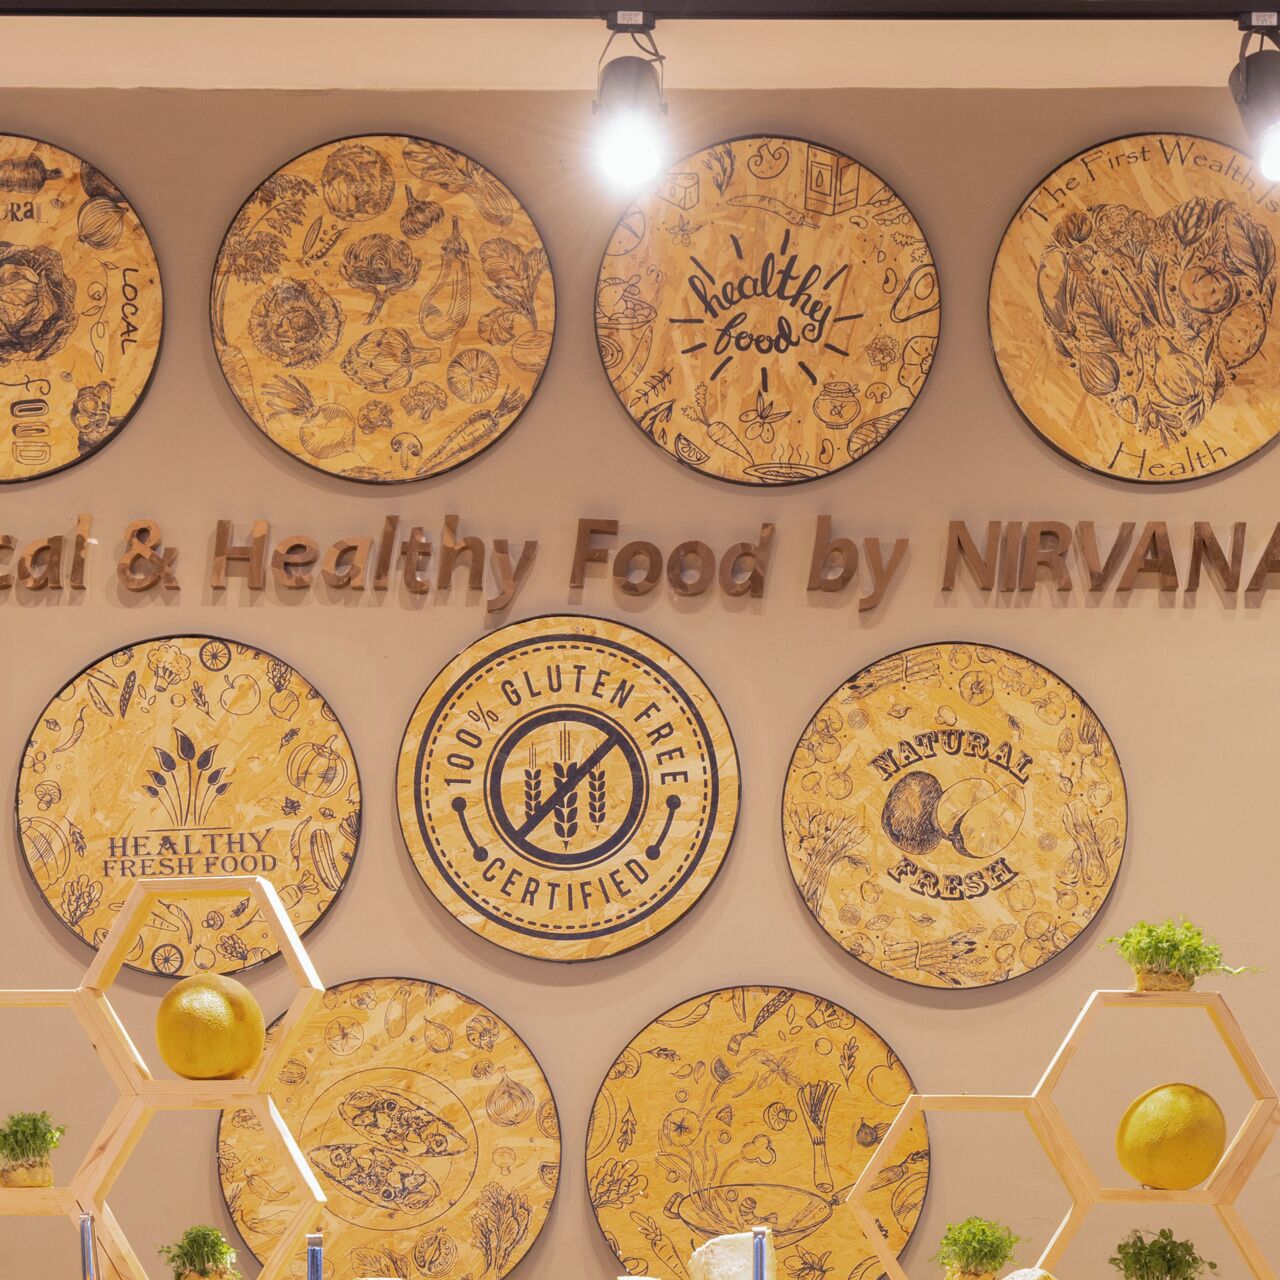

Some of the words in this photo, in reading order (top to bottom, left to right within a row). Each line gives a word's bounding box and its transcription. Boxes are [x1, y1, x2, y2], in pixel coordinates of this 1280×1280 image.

[1019, 177, 1081, 222] The
[1080, 145, 1151, 183] First
[1158, 139, 1256, 191] Wealth
[121, 268, 139, 355] LOCAL
[688, 252, 832, 342] healthy
[714, 312, 800, 355] food
[1107, 440, 1228, 479] Health
[120, 518, 181, 593] &
[209, 513, 538, 614] Healthy
[569, 518, 776, 598] Food
[807, 514, 909, 612] by
[443, 701, 500, 788] 100%
[500, 664, 636, 709] GLUTEN
[634, 701, 690, 786] FREE
[866, 728, 1034, 785] NATURAL
[102, 855, 196, 879] FRESH
[203, 853, 278, 876] FOOD
[108, 828, 273, 857] HEALTHY
[481, 857, 651, 912] CERTIFIED
[886, 854, 1020, 901] FRESH
